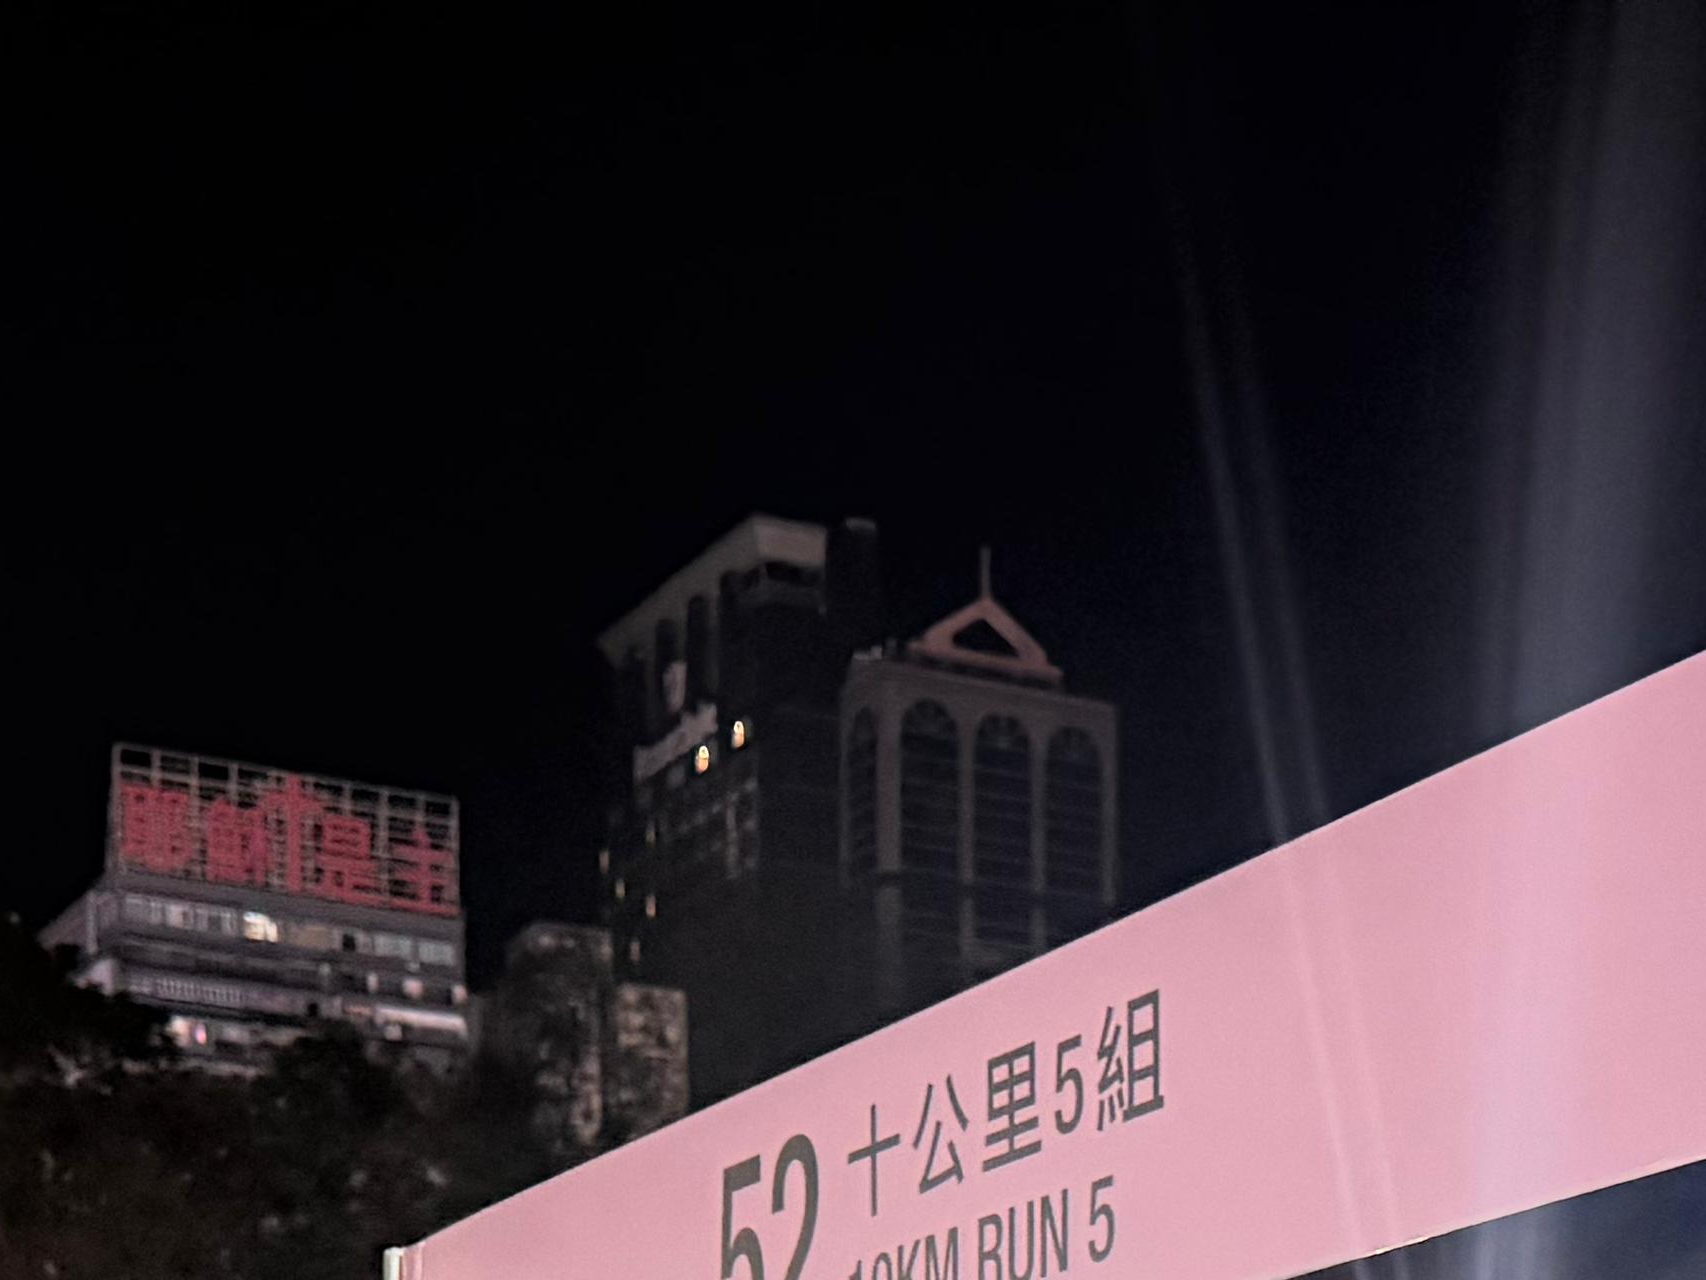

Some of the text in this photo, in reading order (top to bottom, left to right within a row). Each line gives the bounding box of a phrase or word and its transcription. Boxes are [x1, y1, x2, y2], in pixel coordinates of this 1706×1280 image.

[848, 988, 1164, 1217] 十公里5組
[1088, 1175, 1116, 1263] 5
